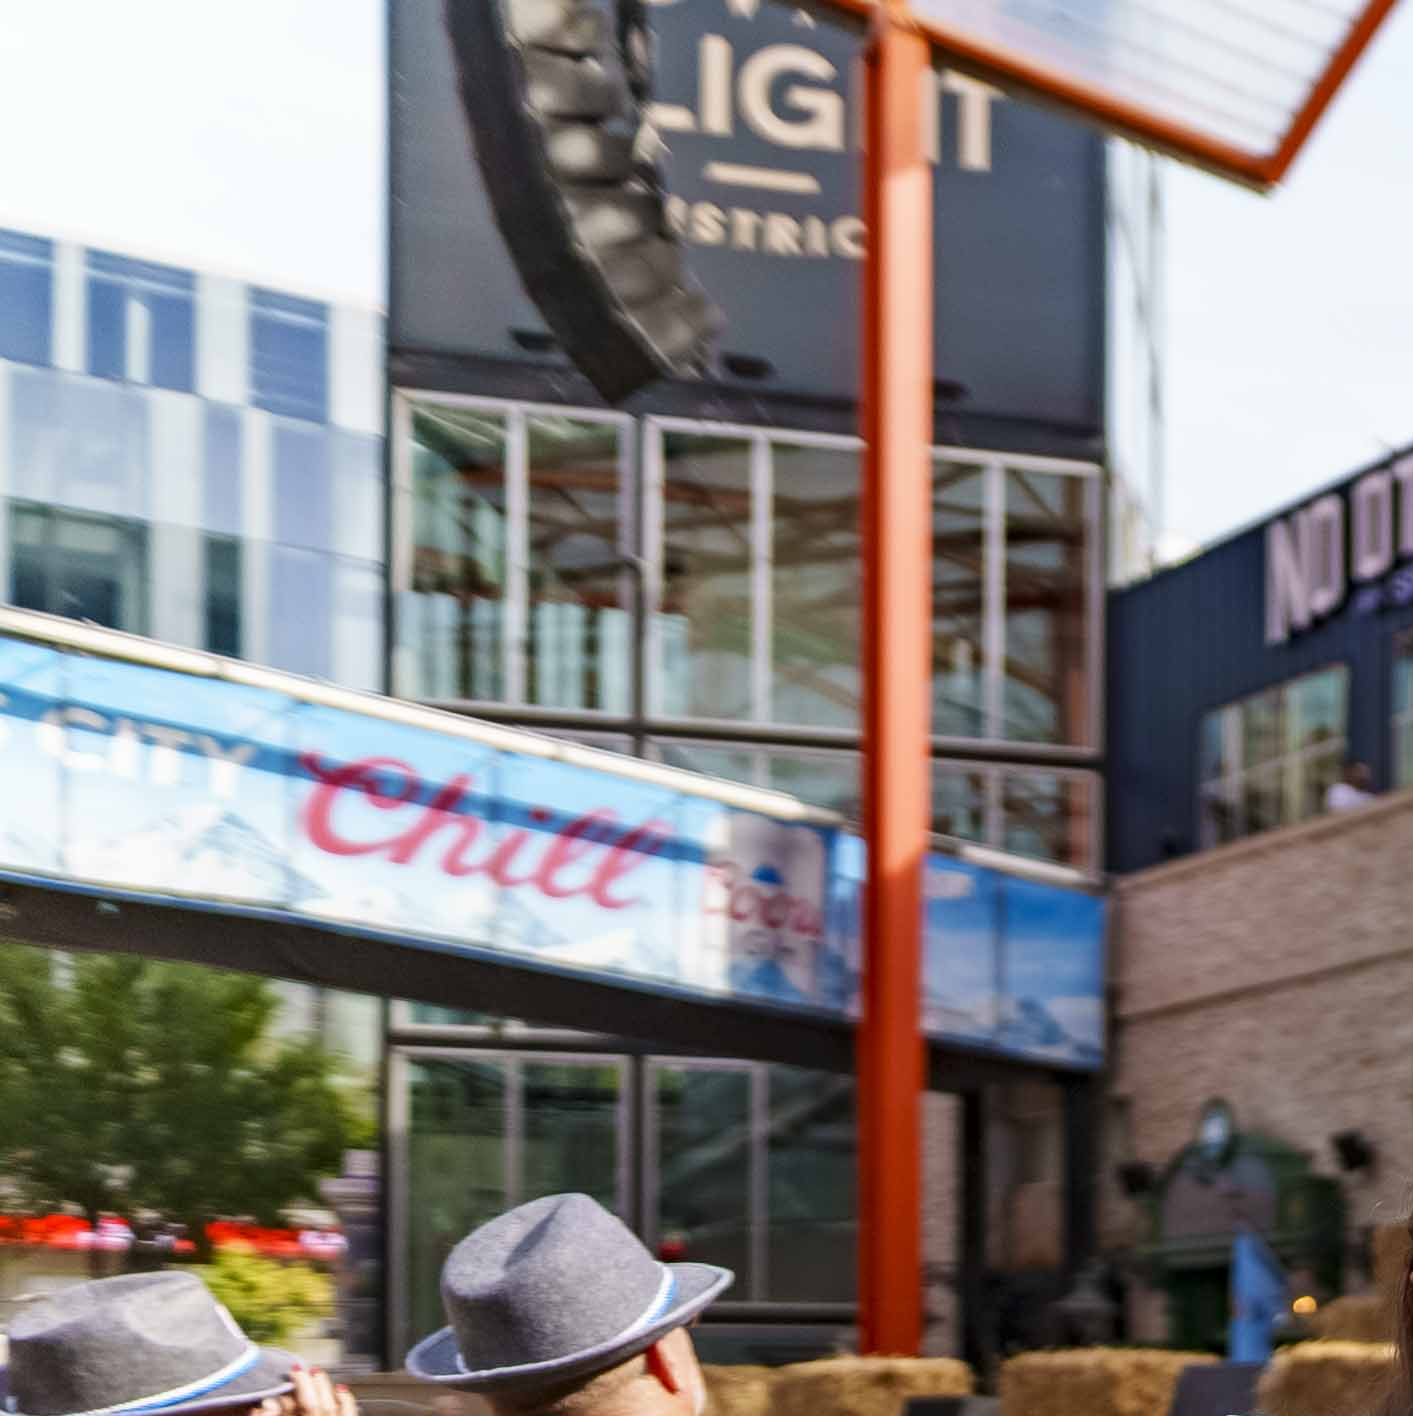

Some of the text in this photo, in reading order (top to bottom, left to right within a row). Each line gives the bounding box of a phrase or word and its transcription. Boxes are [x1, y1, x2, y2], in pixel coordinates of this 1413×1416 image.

[1265, 493, 1345, 645] NO
[34, 704, 260, 800] CITY
[300, 750, 680, 912] Chill
